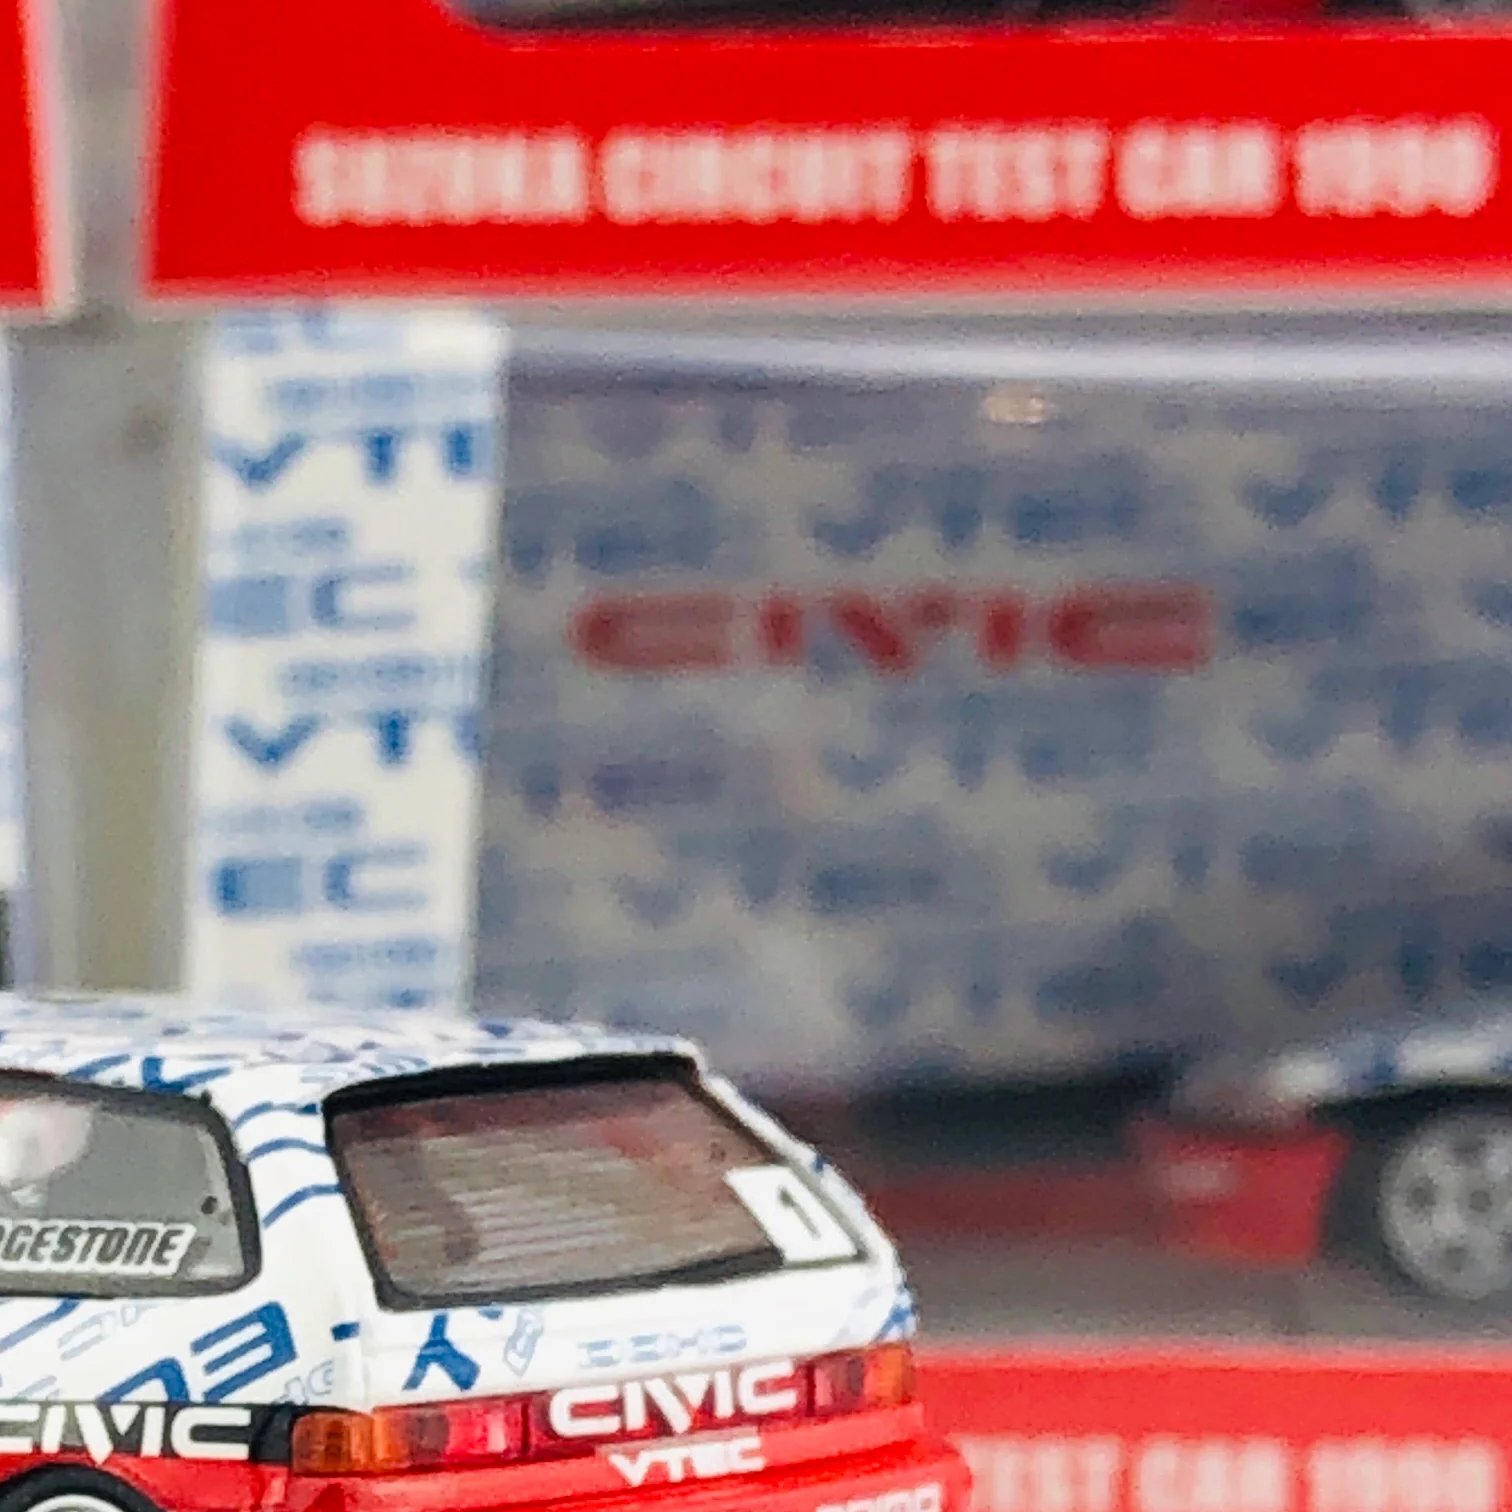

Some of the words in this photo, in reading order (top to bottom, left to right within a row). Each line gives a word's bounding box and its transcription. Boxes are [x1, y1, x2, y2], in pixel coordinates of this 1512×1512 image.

[294, 128, 588, 224] SUZUKA
[600, 126, 906, 224] CIRCUIT
[925, 122, 1104, 220] TEST
[1118, 120, 1280, 218] CAR
[570, 582, 1214, 674] CIVIC
[549, 1362, 798, 1438] CIVIC
[609, 1437, 767, 1487] VTEC
